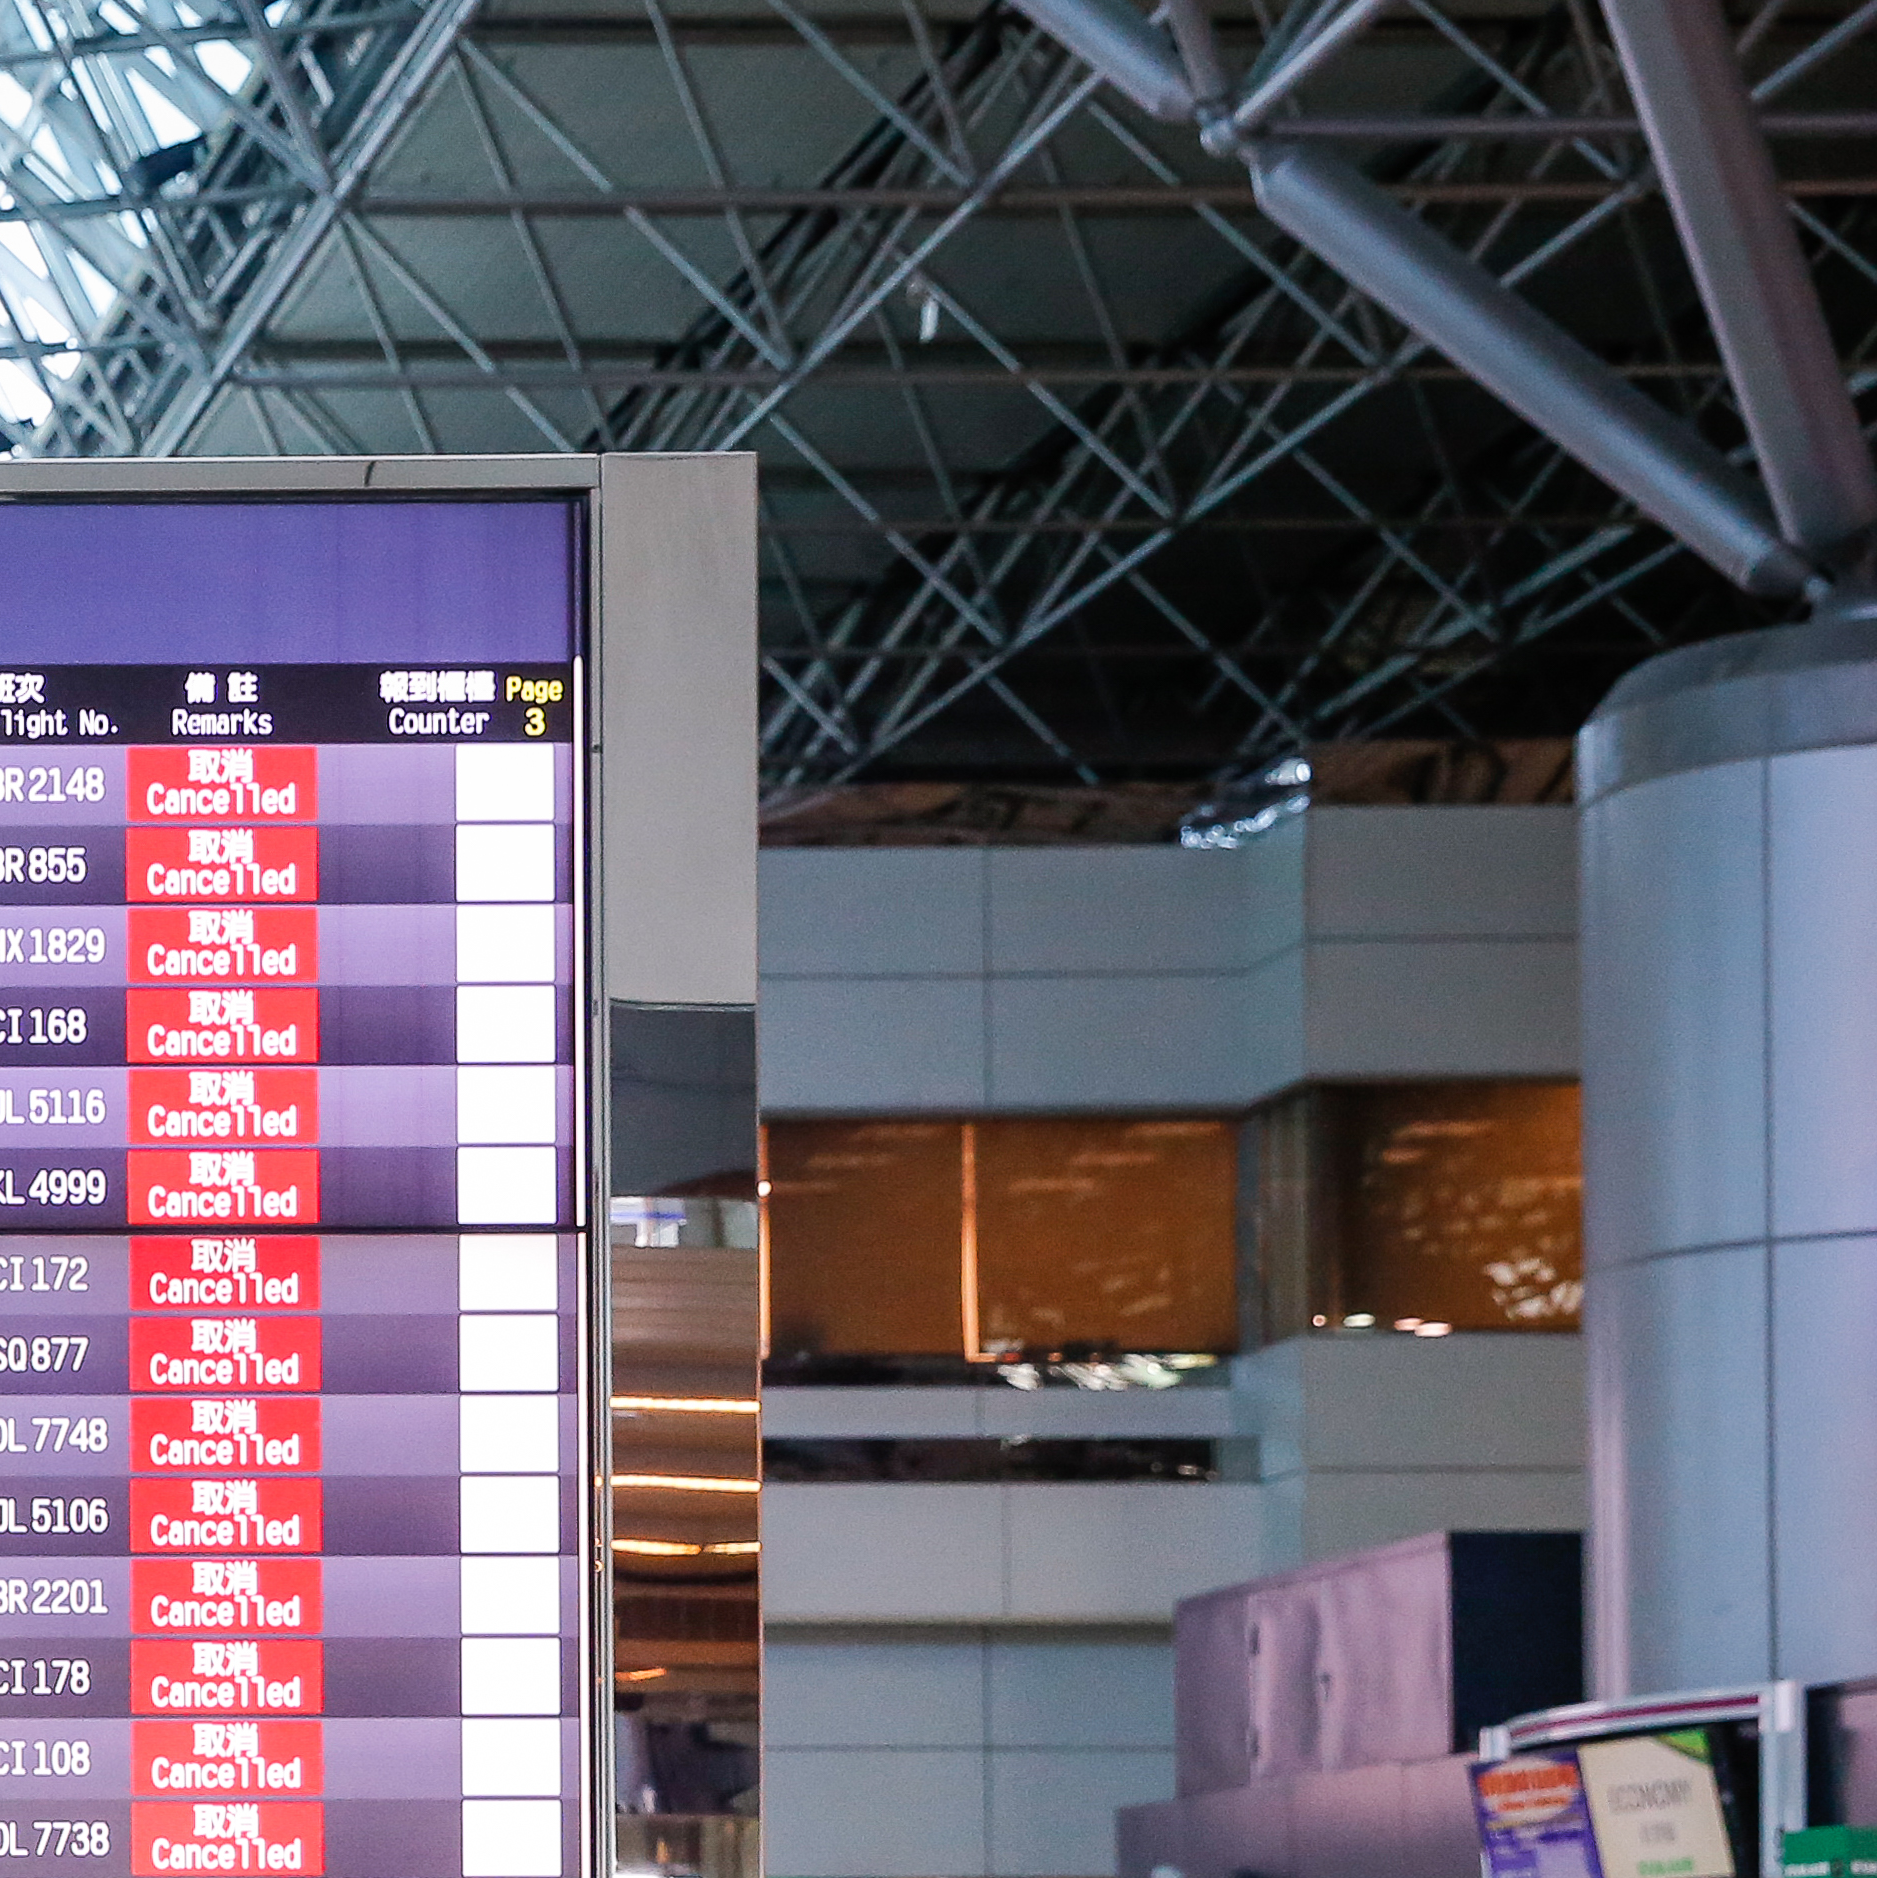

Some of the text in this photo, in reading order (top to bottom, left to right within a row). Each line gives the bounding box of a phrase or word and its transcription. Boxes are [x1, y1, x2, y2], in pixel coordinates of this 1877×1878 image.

[506, 676, 563, 704] Page
[79, 708, 119, 737] No.
[172, 708, 274, 736] Remarks
[388, 707, 491, 734] Counter
[524, 707, 546, 737] 3
[188, 829, 253, 865] 取消
[147, 861, 296, 895] Cancelled
[189, 1151, 254, 1187] 取消
[148, 1183, 297, 1217] Cancelled
[192, 1480, 257, 1515] 取消
[150, 1514, 300, 1546] Cancelled
[193, 1803, 259, 1838] 取消
[152, 1834, 301, 1869] Cancelled
